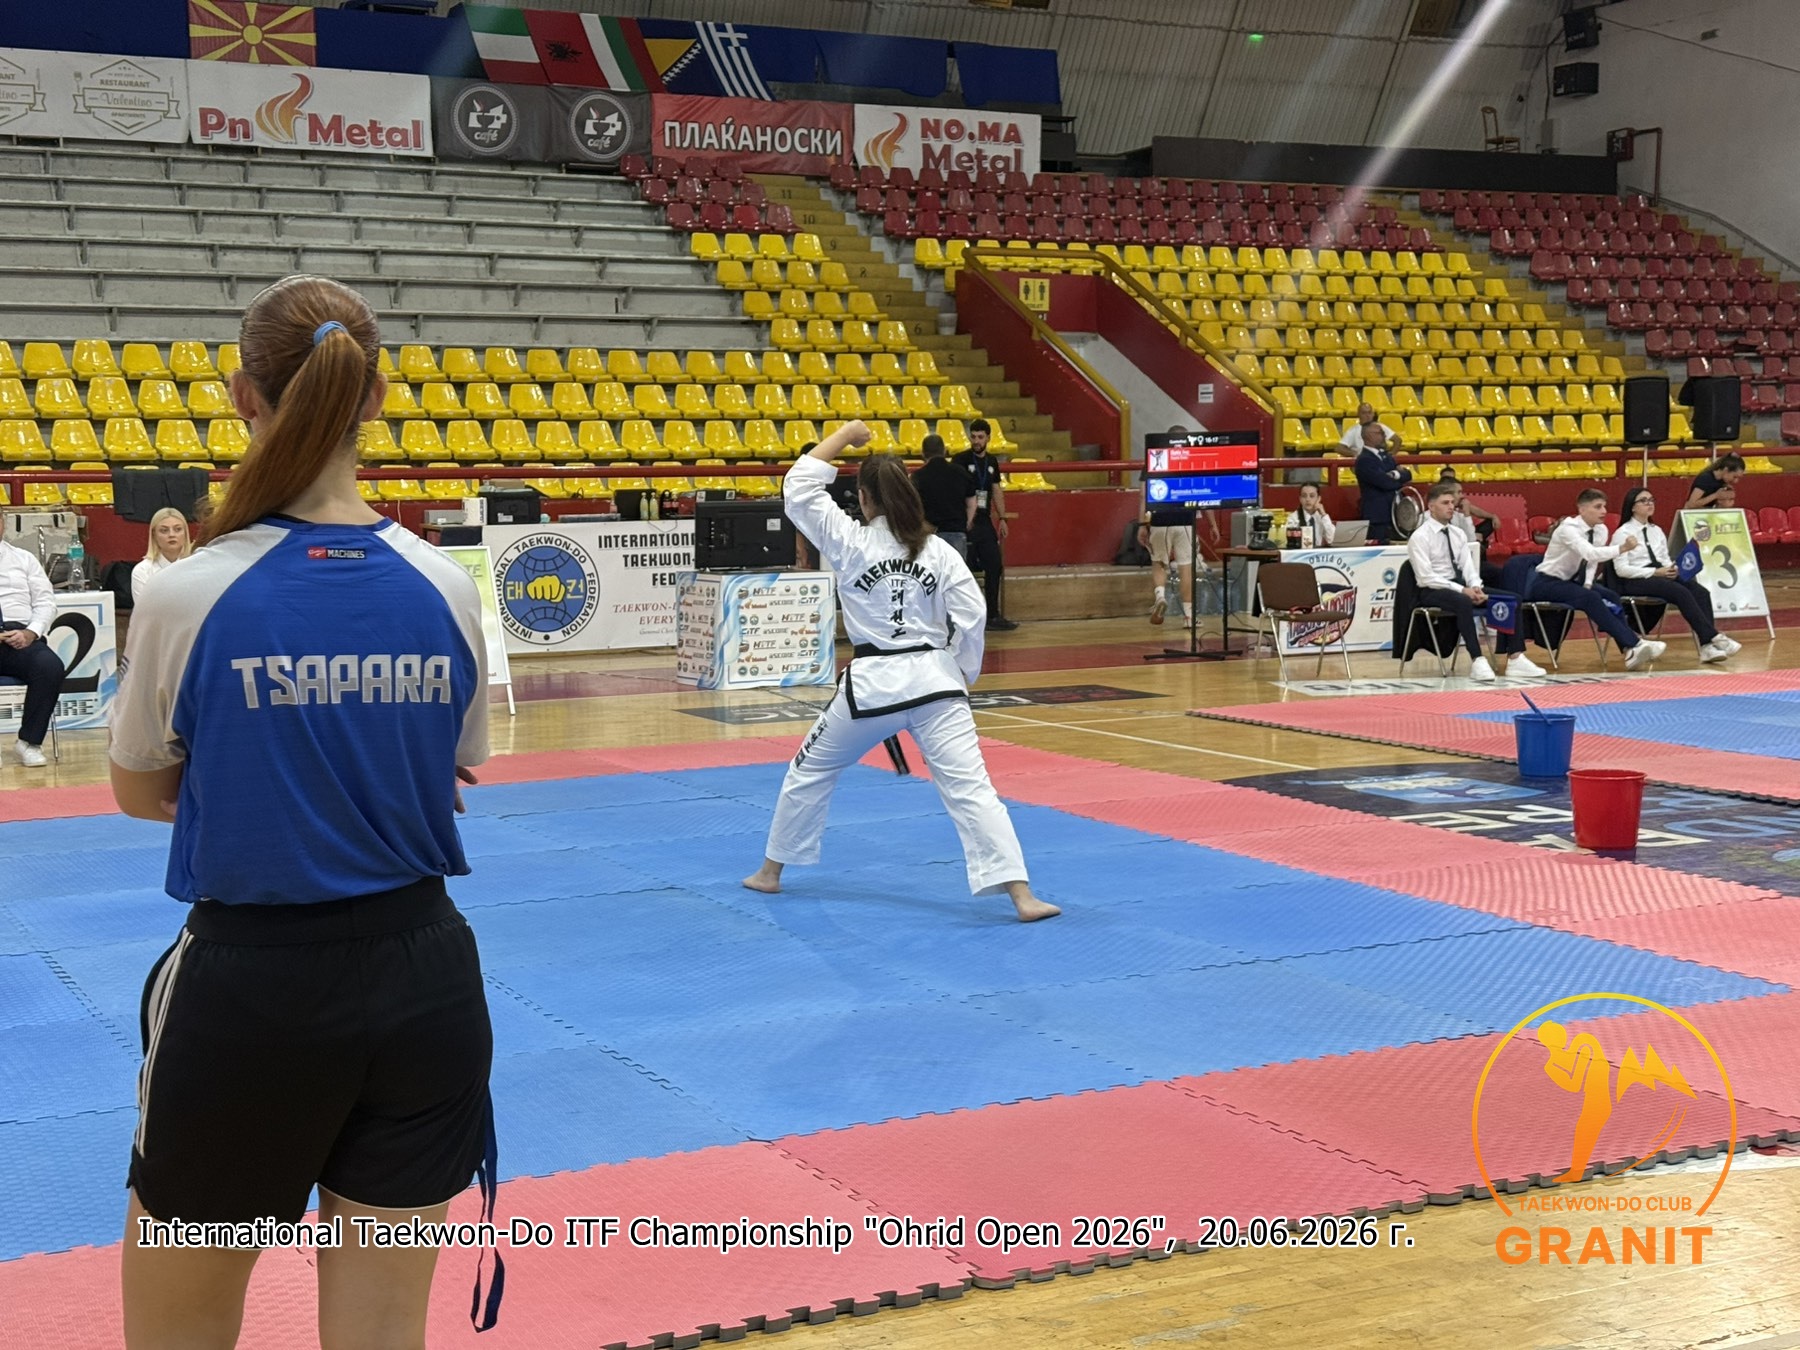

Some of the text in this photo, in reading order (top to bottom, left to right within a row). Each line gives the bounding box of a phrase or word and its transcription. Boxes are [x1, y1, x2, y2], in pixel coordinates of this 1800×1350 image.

[100, 79, 150, 88] RESTAURANT
[199, 107, 423, 149] Pn Metal
[920, 118, 1022, 144] NO.MA
[474, 129, 498, 143] café
[664, 117, 842, 156] ПЛАЌАНОСКИ
[588, 137, 611, 151] café
[922, 143, 1024, 174] Metal
[782, 189, 792, 199] 11
[803, 214, 816, 225] 10
[831, 240, 837, 251] 9
[886, 294, 892, 306] 7
[914, 323, 922, 334] 6
[976, 386, 983, 398] 4
[327, 549, 365, 559] MACHINES
[1711, 545, 1738, 589] 3
[853, 558, 938, 597] TAEKWON-DO
[561, 572, 597, 638] FEDERATION
[639, 615, 675, 625] EVERY
[48, 612, 101, 693] 2
[231, 655, 450, 708] TSAPARA
